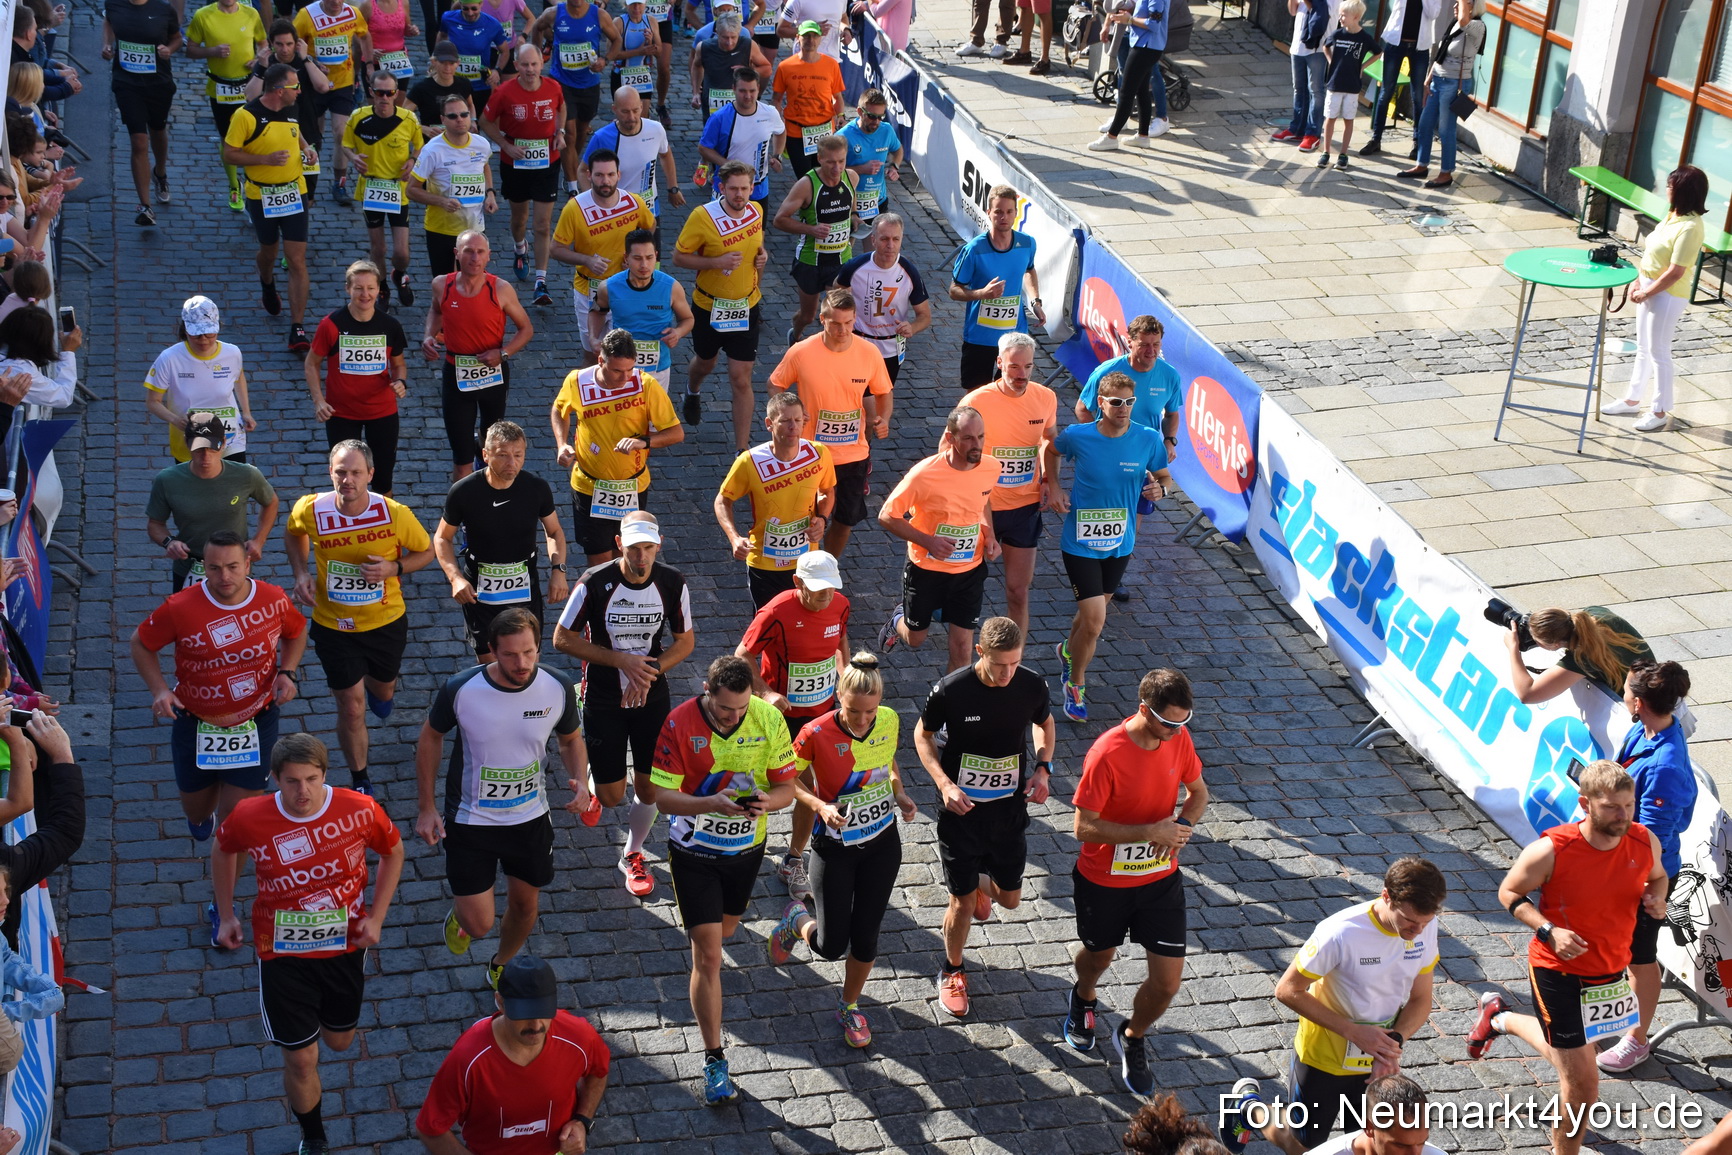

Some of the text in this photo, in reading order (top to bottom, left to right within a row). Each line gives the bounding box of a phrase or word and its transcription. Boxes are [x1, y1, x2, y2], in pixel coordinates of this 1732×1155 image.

[645, 5, 665, 14] 2428
[123, 52, 150, 63] 2672
[319, 46, 345, 56] 2842
[563, 52, 588, 62] 1133
[383, 60, 408, 70] 2422
[625, 75, 649, 85] 2268
[367, 180, 397, 189] BOCK
[454, 175, 482, 183] BOCK
[368, 190, 397, 202] 2798
[454, 185, 482, 196] 2794
[267, 192, 297, 206] 2608
[589, 213, 640, 237] MAX BÖGL
[722, 233, 745, 248] MAX
[716, 299, 748, 308] BOCK
[716, 310, 746, 321] 2388
[985, 307, 1016, 319] 1379
[344, 337, 382, 346] BOCK
[345, 350, 382, 362] 2664
[343, 363, 382, 371] ELISABETH
[466, 377, 494, 387] ROLAND
[583, 397, 646, 420] MAX BÖGL
[822, 412, 858, 420] BOCK
[822, 422, 856, 434] 2534
[1190, 381, 1249, 479] Hervis
[996, 448, 1035, 458] BOCK
[1196, 439, 1220, 470] SPORTS
[1000, 460, 1033, 474] 2538
[599, 480, 632, 490] BOCK
[764, 465, 824, 494] MAX BÖGL
[598, 492, 632, 507] 2397
[1081, 511, 1123, 520] BOCK
[769, 520, 807, 534] BOCK
[942, 526, 976, 535] BOCK
[1082, 523, 1122, 537] 2480
[320, 528, 396, 550] MAX BÖGL
[769, 533, 806, 548] 2403
[775, 549, 801, 557] BERND
[482, 563, 526, 576] BOCK
[483, 577, 524, 592] 2702
[333, 592, 377, 600] MATTHIAS
[241, 596, 290, 630] raum
[1270, 470, 1533, 745] stackstar
[794, 663, 833, 676] BOCK
[794, 673, 832, 692] 2331
[795, 690, 830, 703] HERBERT
[523, 709, 544, 717] swn
[204, 735, 252, 752] 2262
[206, 753, 251, 763] ANDREAS
[966, 757, 1015, 770] BOCK
[486, 766, 538, 779] BOCK
[965, 772, 1013, 788] 2783
[486, 778, 534, 798] 2715
[847, 801, 890, 828] 2689
[313, 807, 374, 844] raum
[702, 818, 752, 836] 2688
[860, 821, 884, 838] NINA
[275, 830, 305, 844] raumbox
[707, 834, 750, 846] JOHANNES
[1123, 859, 1161, 871] DOMINIK
[282, 912, 340, 925] BOCK
[283, 927, 339, 941] 2264
[285, 939, 336, 950] RAIMUND
[1360, 957, 1381, 965] BOCK
[1589, 996, 1634, 1022] 2202
[1597, 1018, 1629, 1034] PIERRE
